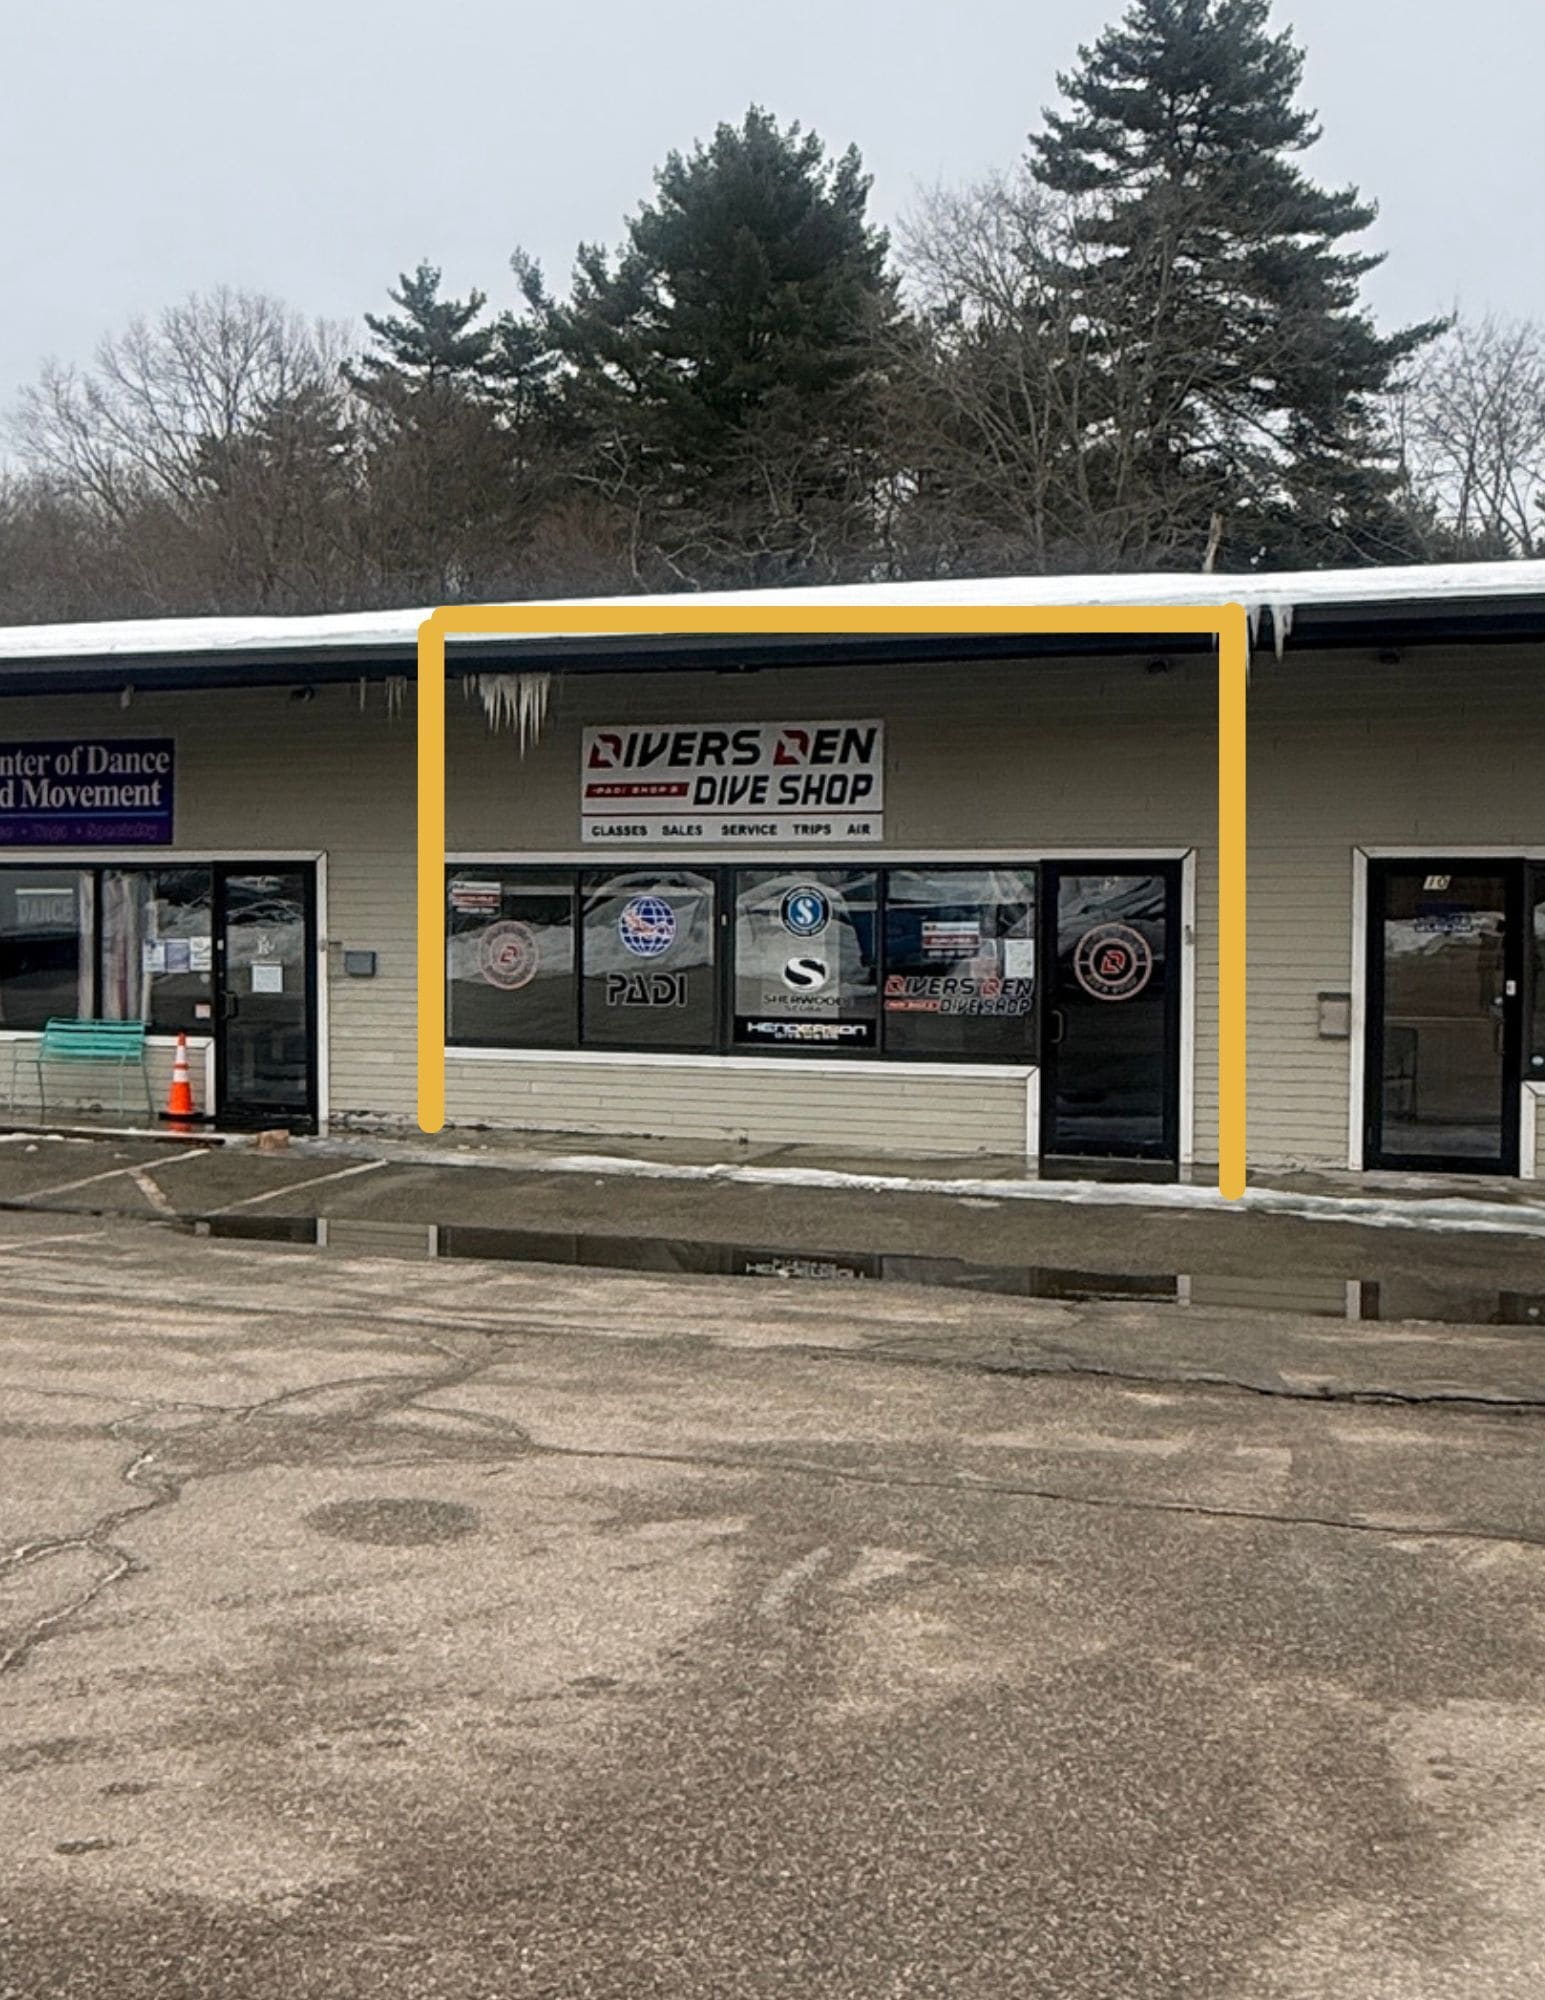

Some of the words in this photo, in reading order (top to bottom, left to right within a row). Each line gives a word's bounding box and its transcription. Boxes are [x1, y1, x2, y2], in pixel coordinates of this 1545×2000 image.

[55, 745, 83, 775] of
[86, 745, 170, 775] Dance
[588, 729, 761, 768] DIVERS
[773, 727, 877, 765] DEN
[20, 778, 163, 809] Movement
[693, 775, 770, 805] DIVE
[778, 774, 873, 805] SHOP
[591, 825, 648, 836] CLASSES
[662, 825, 703, 836] SALES
[721, 824, 778, 836] SERVICE
[792, 823, 831, 835] TRIPS
[847, 823, 871, 835] AIR
[606, 972, 688, 1007] PADI
[885, 975, 976, 997] DIVERS
[981, 976, 1034, 998] DEN
